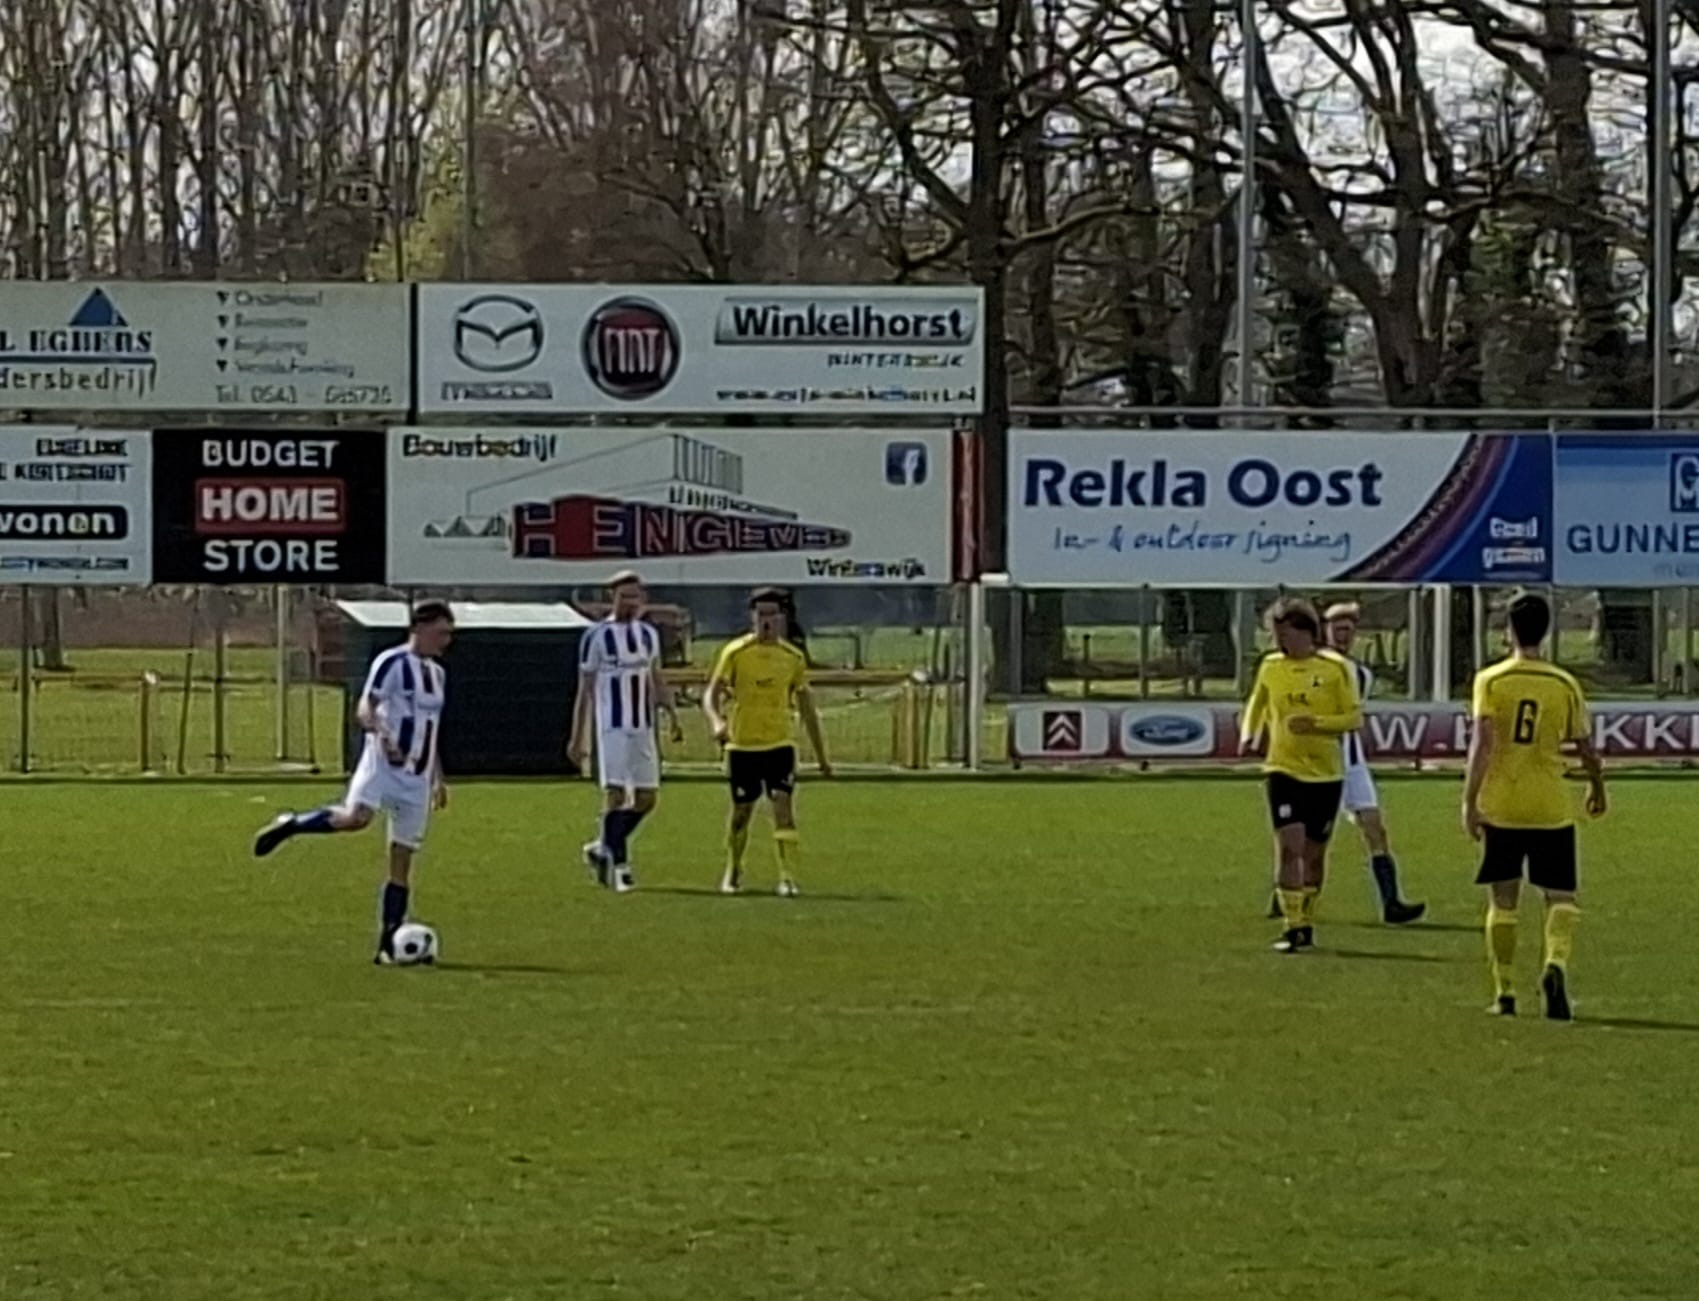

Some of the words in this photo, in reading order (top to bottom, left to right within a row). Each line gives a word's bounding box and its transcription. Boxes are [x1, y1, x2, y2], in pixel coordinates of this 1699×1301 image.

[733, 303, 963, 338] Winkelhorst
[203, 440, 339, 468] BUDGET
[1024, 460, 1206, 507] Rekla
[1227, 459, 1382, 507] Oost
[203, 488, 338, 520] HOME
[203, 540, 339, 571] STORE
[1245, 520, 1350, 562] signing
